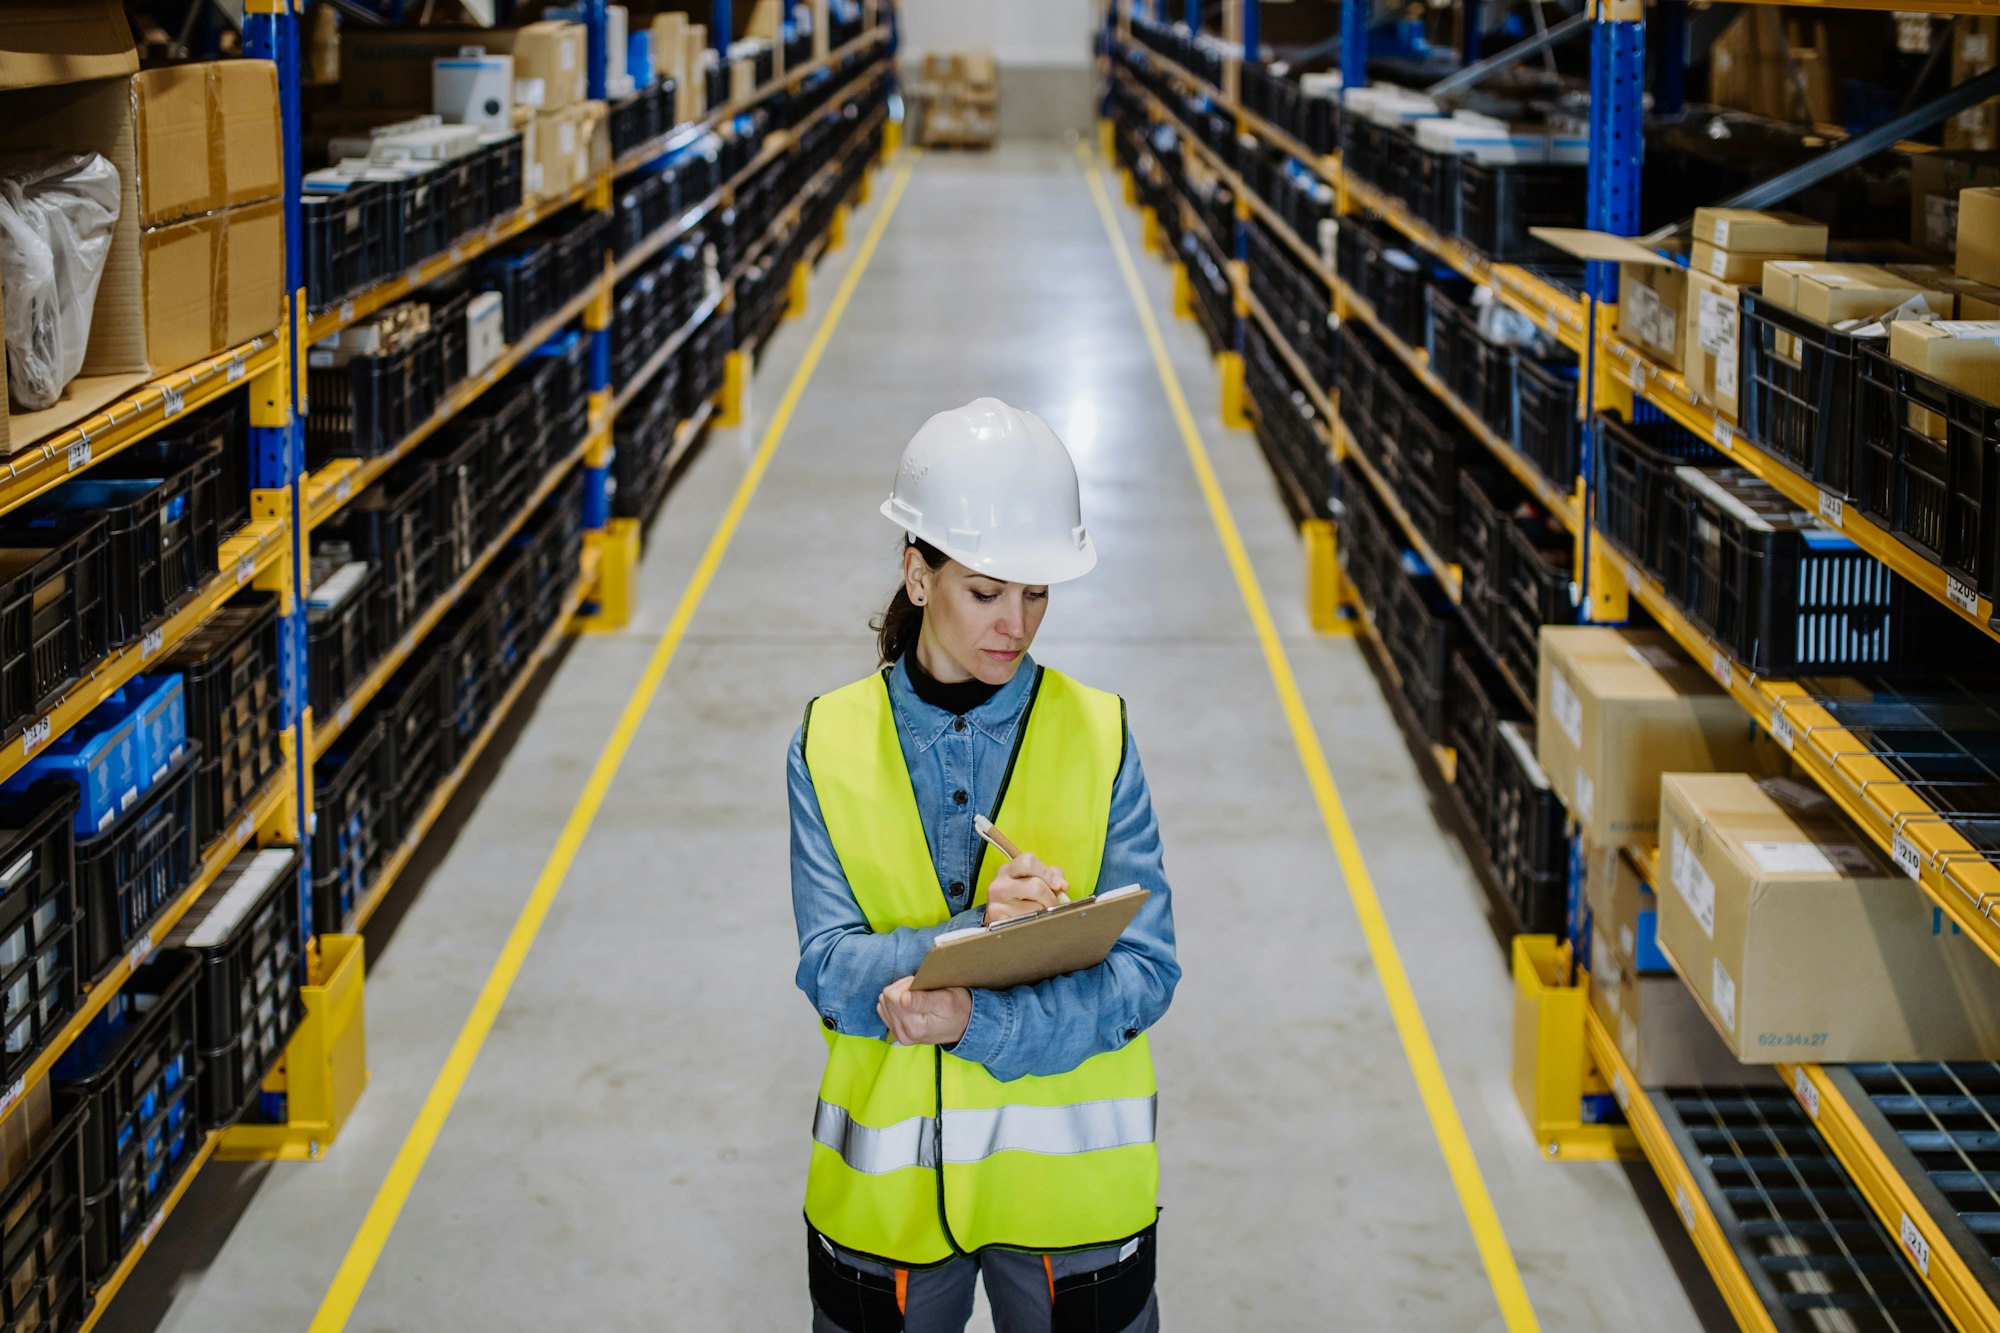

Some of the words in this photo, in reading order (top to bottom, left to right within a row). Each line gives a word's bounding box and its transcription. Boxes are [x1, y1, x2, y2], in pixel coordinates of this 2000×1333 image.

[69, 440, 91, 460] 13177
[1894, 838, 1919, 869] 13210
[1903, 1220, 1928, 1264] 13211
